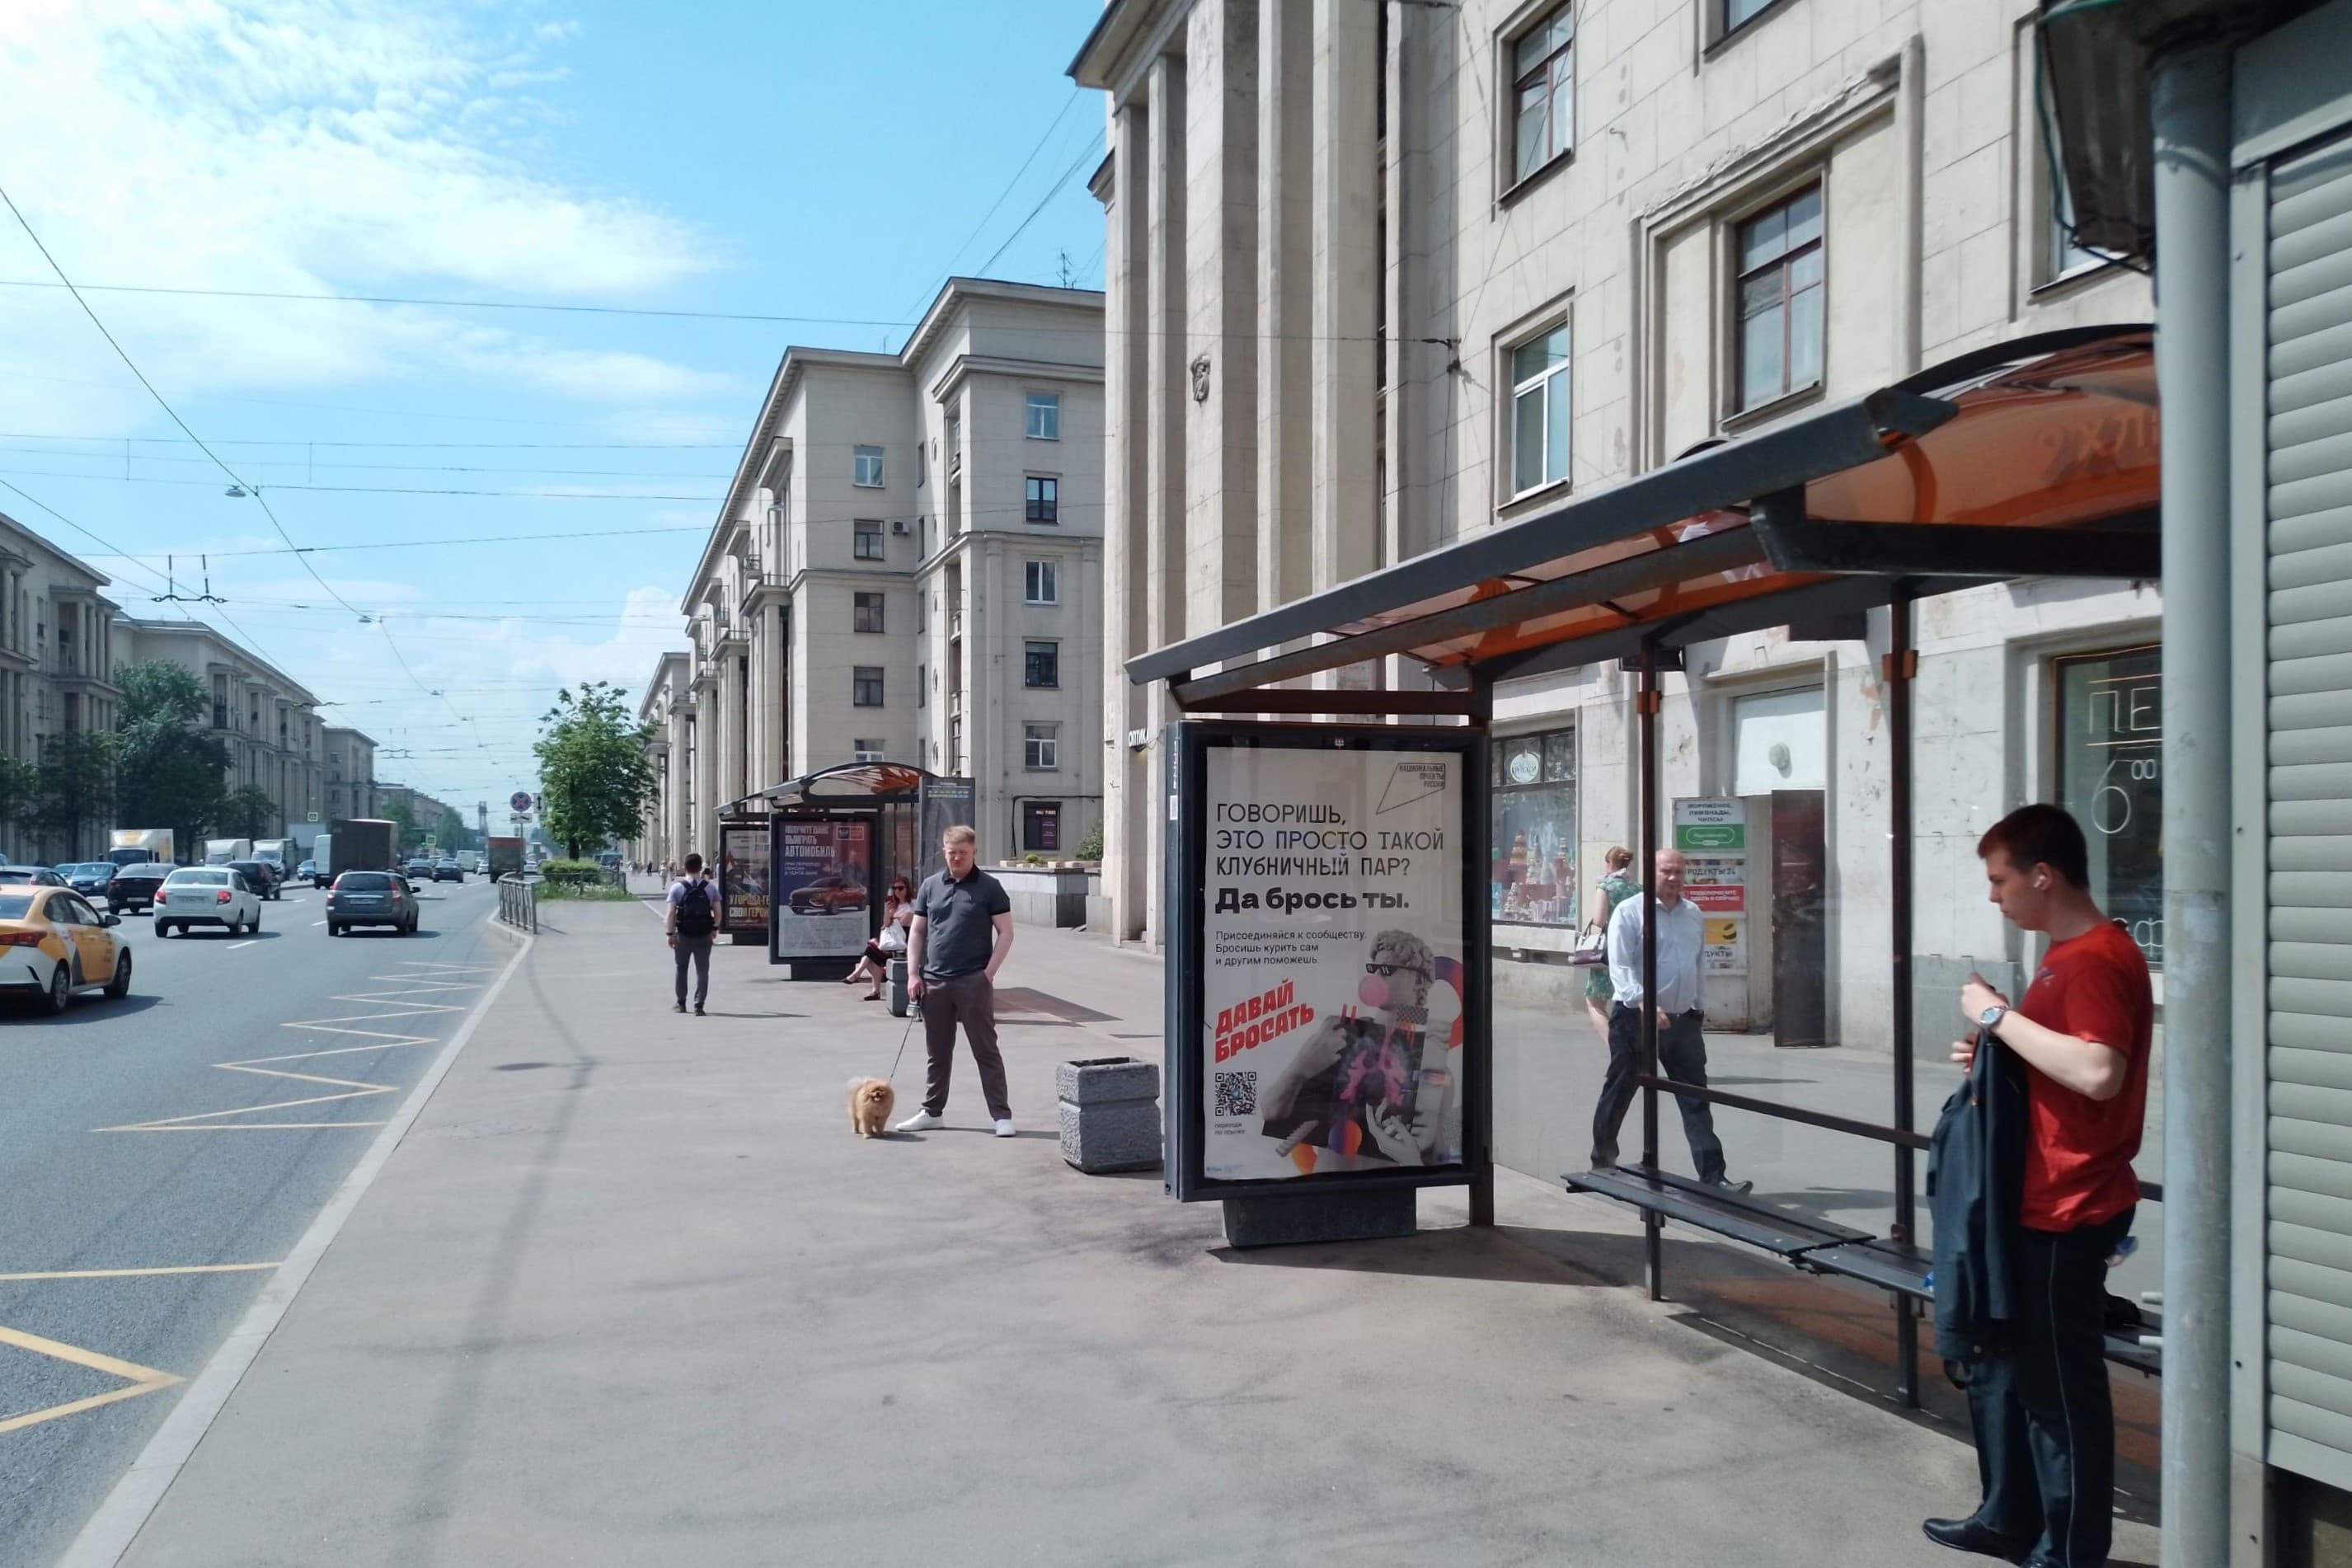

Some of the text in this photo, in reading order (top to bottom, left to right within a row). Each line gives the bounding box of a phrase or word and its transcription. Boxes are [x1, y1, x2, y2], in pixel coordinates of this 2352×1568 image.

[1217, 803, 1346, 825] ГОВОРИШЬ,
[1216, 828, 1444, 851] ЭТО ПРОСТО ТАКОЙ
[784, 846, 836, 857] АВТОМОБИЛЬ
[1360, 857, 1411, 876] ПАР?
[1687, 867, 1725, 876] РОДУКТЫ
[1214, 886, 1410, 915] Да брось ты.
[1215, 930, 1295, 941] Присоединяйся
[1215, 943, 1261, 954] Бросишь
[1264, 944, 1298, 954] курить
[1224, 957, 1261, 967] другим
[1214, 979, 1293, 1039] ДАВАЙ
[1214, 1002, 1315, 1064] БРОСАТЬ
